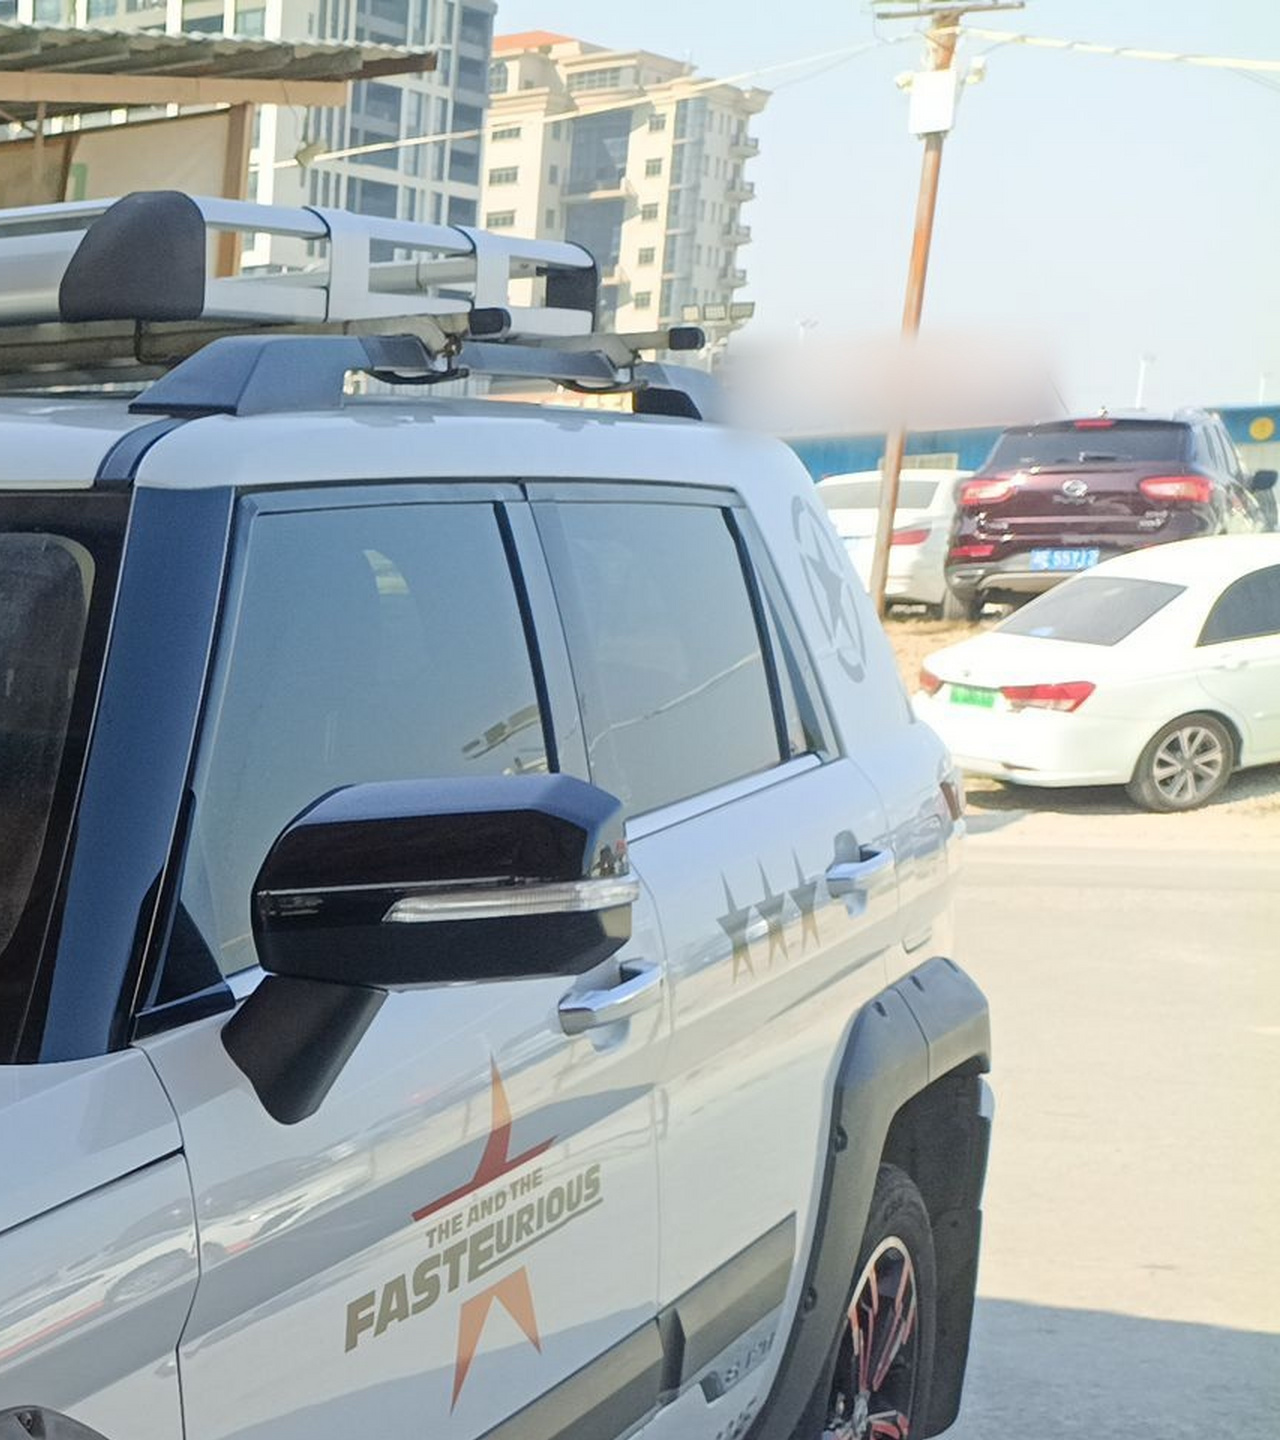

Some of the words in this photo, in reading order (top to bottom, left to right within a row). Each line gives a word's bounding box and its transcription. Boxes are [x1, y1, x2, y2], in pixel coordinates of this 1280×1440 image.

[426, 1213, 463, 1249] THE
[467, 1189, 507, 1228] AND
[509, 1168, 542, 1201] THE
